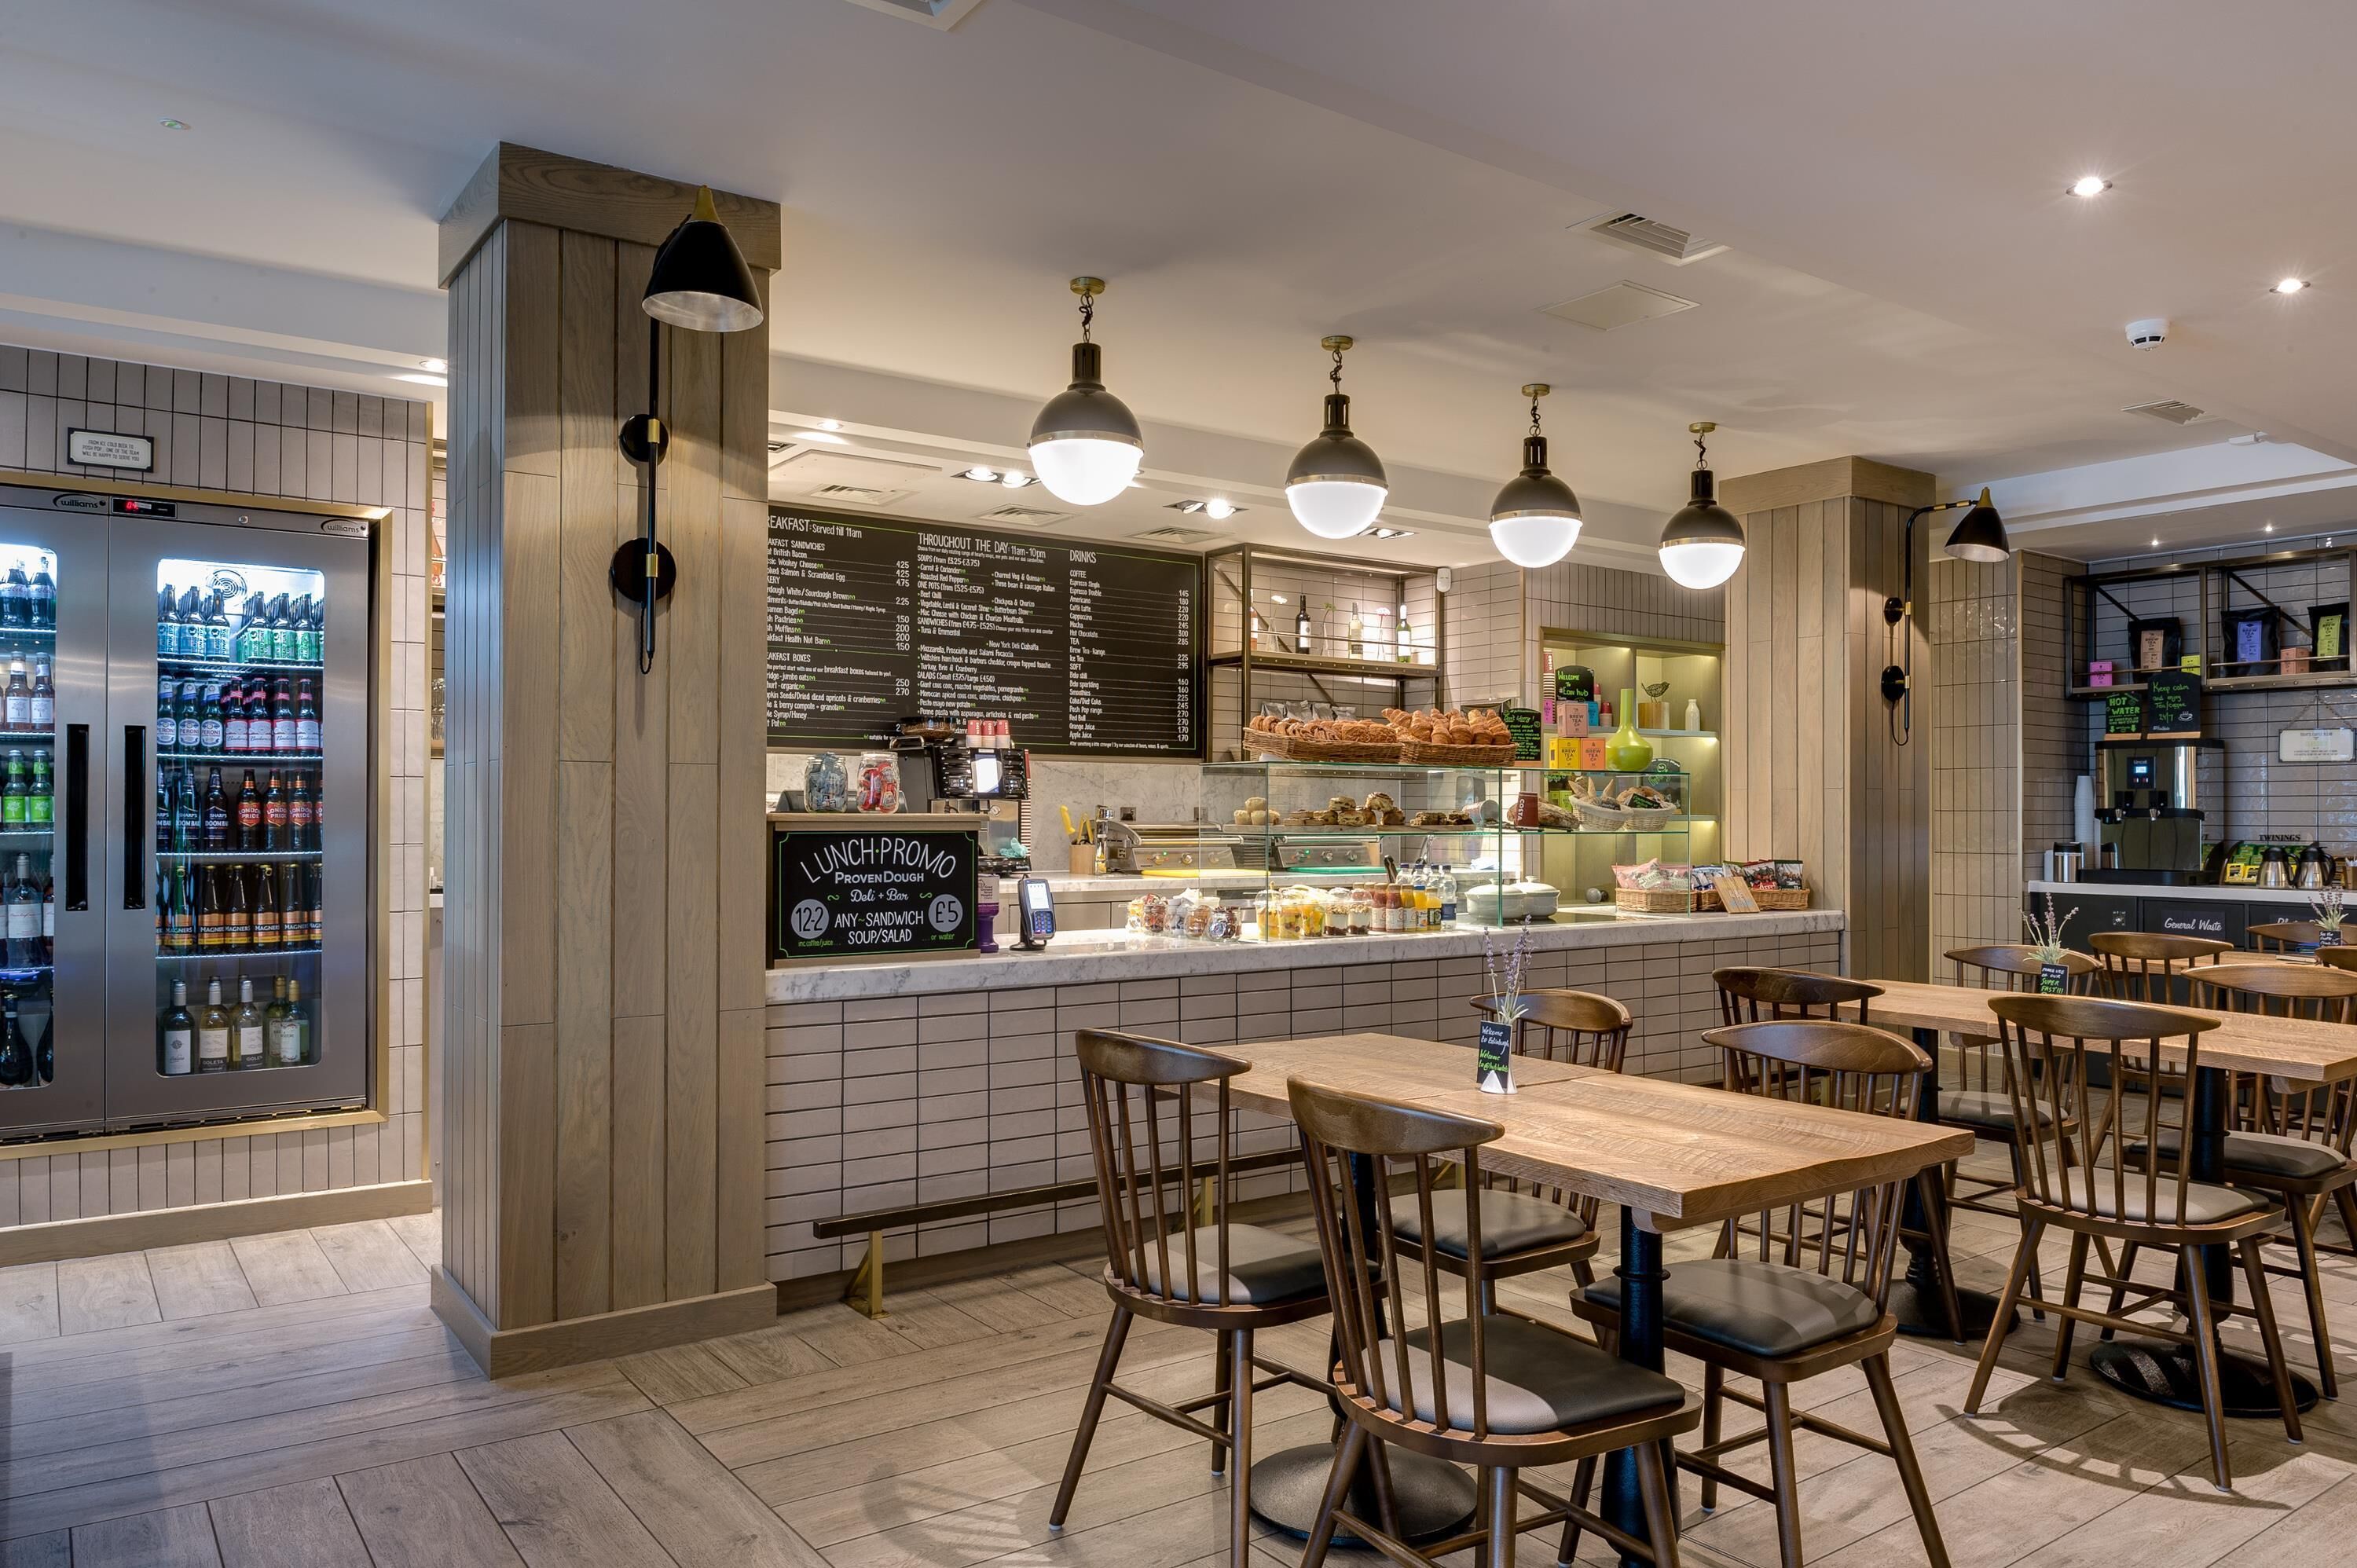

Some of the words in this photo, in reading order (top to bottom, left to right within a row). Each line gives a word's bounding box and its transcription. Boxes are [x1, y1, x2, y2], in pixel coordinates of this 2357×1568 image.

[60, 499, 98, 509] williams
[327, 523, 360, 533] williams
[812, 523, 834, 535] Served
[845, 526, 862, 539] 11am
[791, 540, 826, 551] SANDWICHES
[918, 533, 971, 550] THROUGHOUT
[975, 538, 992, 552] THE
[773, 548, 790, 557] British
[1070, 549, 1097, 563] DRINKS
[918, 554, 933, 562] SOUPS
[780, 568, 799, 577] Salmon
[808, 570, 834, 580] Scrambled
[836, 573, 845, 582] Egg
[1070, 570, 1087, 578] COFFEE
[929, 582, 940, 591] POTS
[1070, 579, 1087, 588] Espresso
[1088, 581, 1100, 589] Single
[1070, 587, 1087, 595] Espresso
[1070, 612, 1093, 621] Cappuccino
[918, 617, 948, 627] SANDWICHES
[921, 626, 931, 635] Tuna
[792, 653, 811, 663] BOXES
[918, 671, 936, 680] SALADS
[2153, 681, 2170, 694] Keep
[2110, 697, 2127, 706] HOT
[2112, 706, 2140, 715] WATER
[850, 888, 875, 902] Deli
[886, 888, 908, 901] Bar
[936, 901, 958, 924] £5
[795, 907, 824, 932] 12-2
[866, 910, 924, 927] SANDWICH
[2165, 918, 2196, 930] General
[2198, 919, 2222, 931] Waste
[848, 928, 911, 944] SOUP/SALAD
[1482, 1026, 1503, 1037] Welcome
[1480, 1049, 1501, 1061] Welcome
